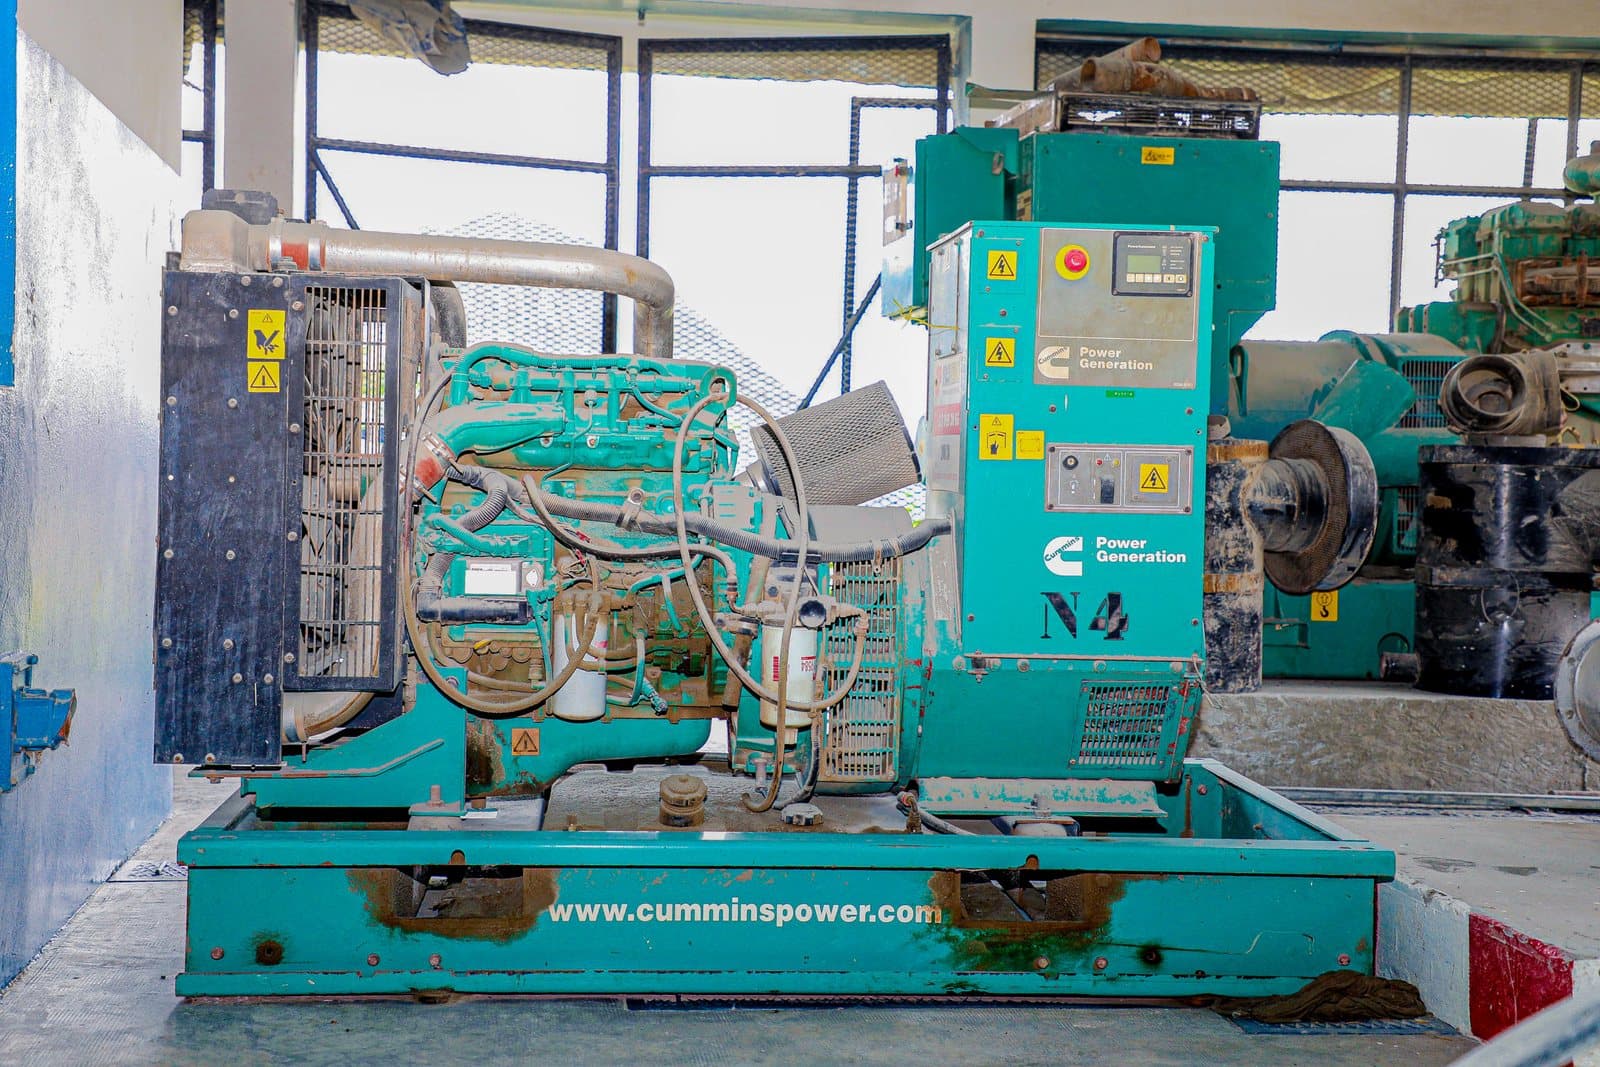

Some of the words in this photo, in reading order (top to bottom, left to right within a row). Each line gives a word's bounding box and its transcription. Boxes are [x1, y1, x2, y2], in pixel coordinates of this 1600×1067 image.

[1079, 346, 1122, 358] Power
[1079, 359, 1153, 370] Generation
[1044, 536, 1080, 562] Cummins
[1096, 536, 1147, 549] Power
[1096, 550, 1186, 563] Generation
[549, 897, 942, 927] www.cumminspower.com
